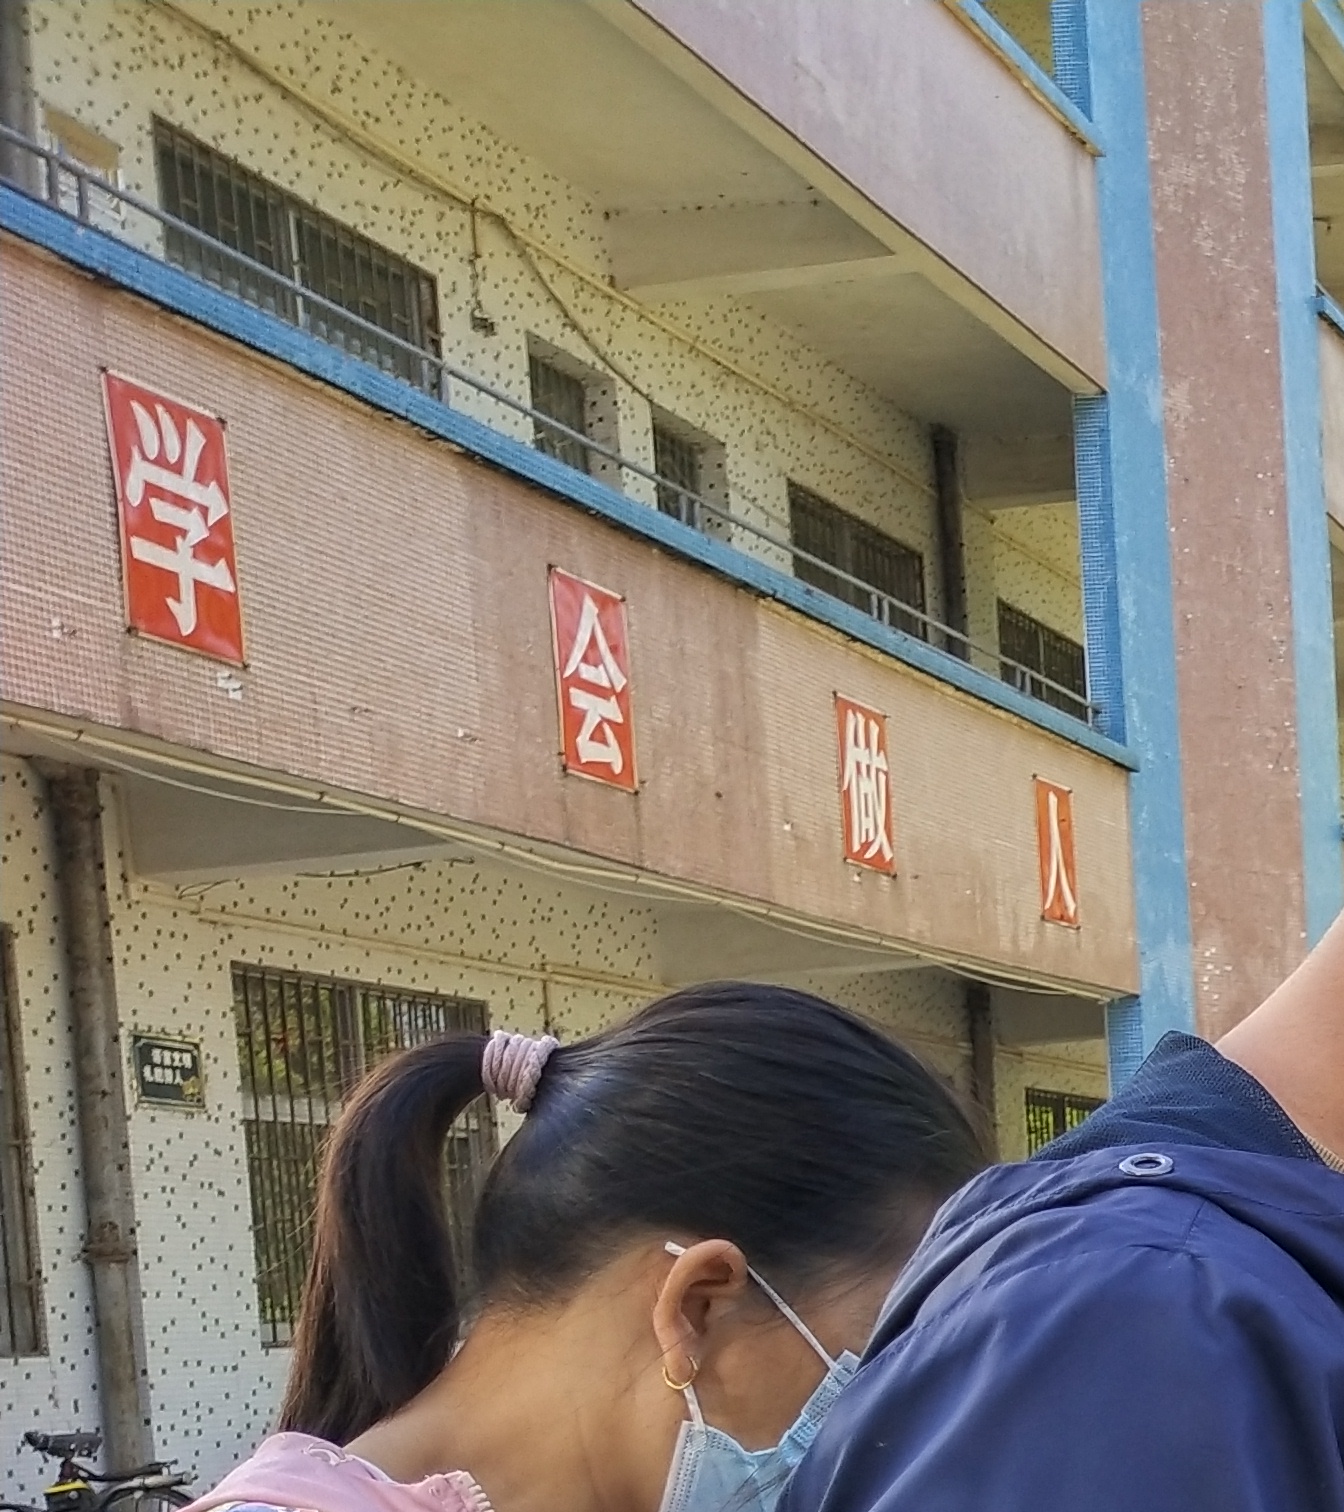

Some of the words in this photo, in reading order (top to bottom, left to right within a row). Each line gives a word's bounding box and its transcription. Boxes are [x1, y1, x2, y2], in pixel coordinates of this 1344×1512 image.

[126, 398, 236, 638] 学
[562, 594, 628, 775] 会
[840, 710, 891, 862] 做
[1044, 792, 1076, 917] 人
